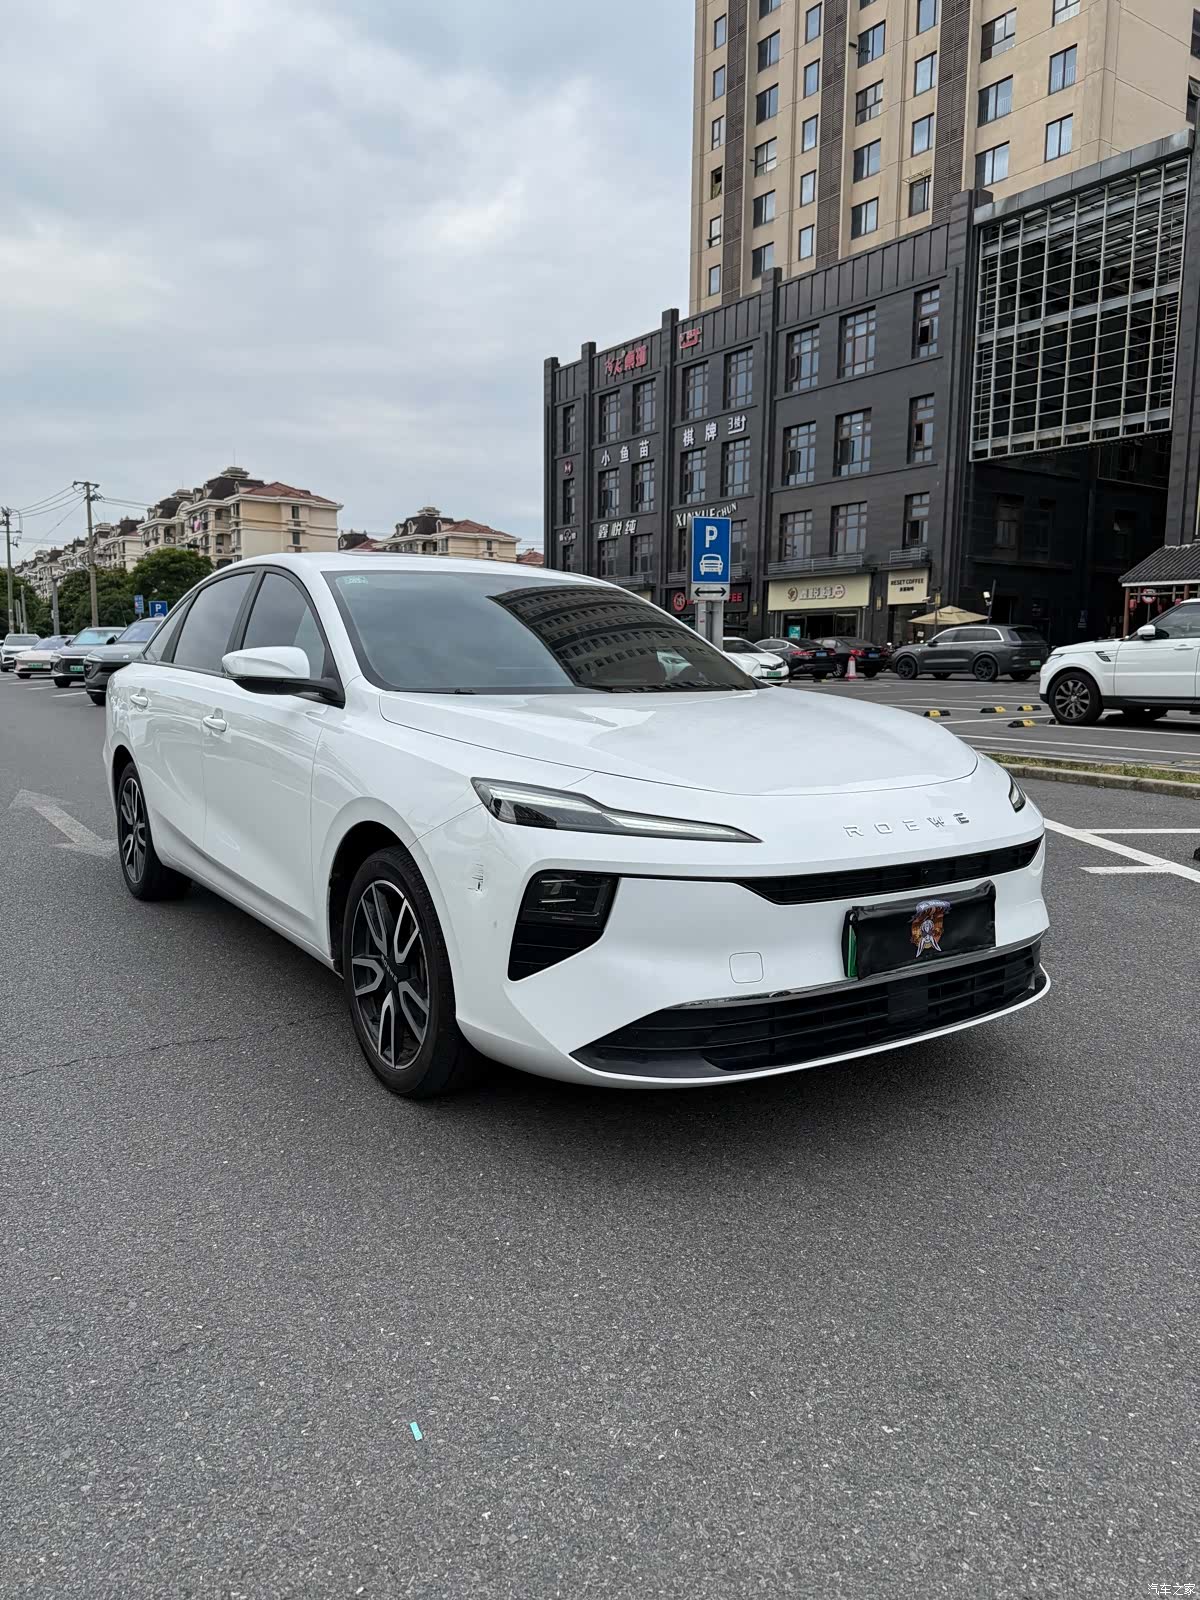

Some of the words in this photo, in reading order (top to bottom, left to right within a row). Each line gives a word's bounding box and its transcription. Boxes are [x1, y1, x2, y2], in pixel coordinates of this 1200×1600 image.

[601, 440, 650, 466] 小鱼苗
[683, 422, 717, 447] 棋牌
[705, 525, 718, 548] P
[155, 603, 162, 612] P
[842, 812, 970, 837] ROEWE
